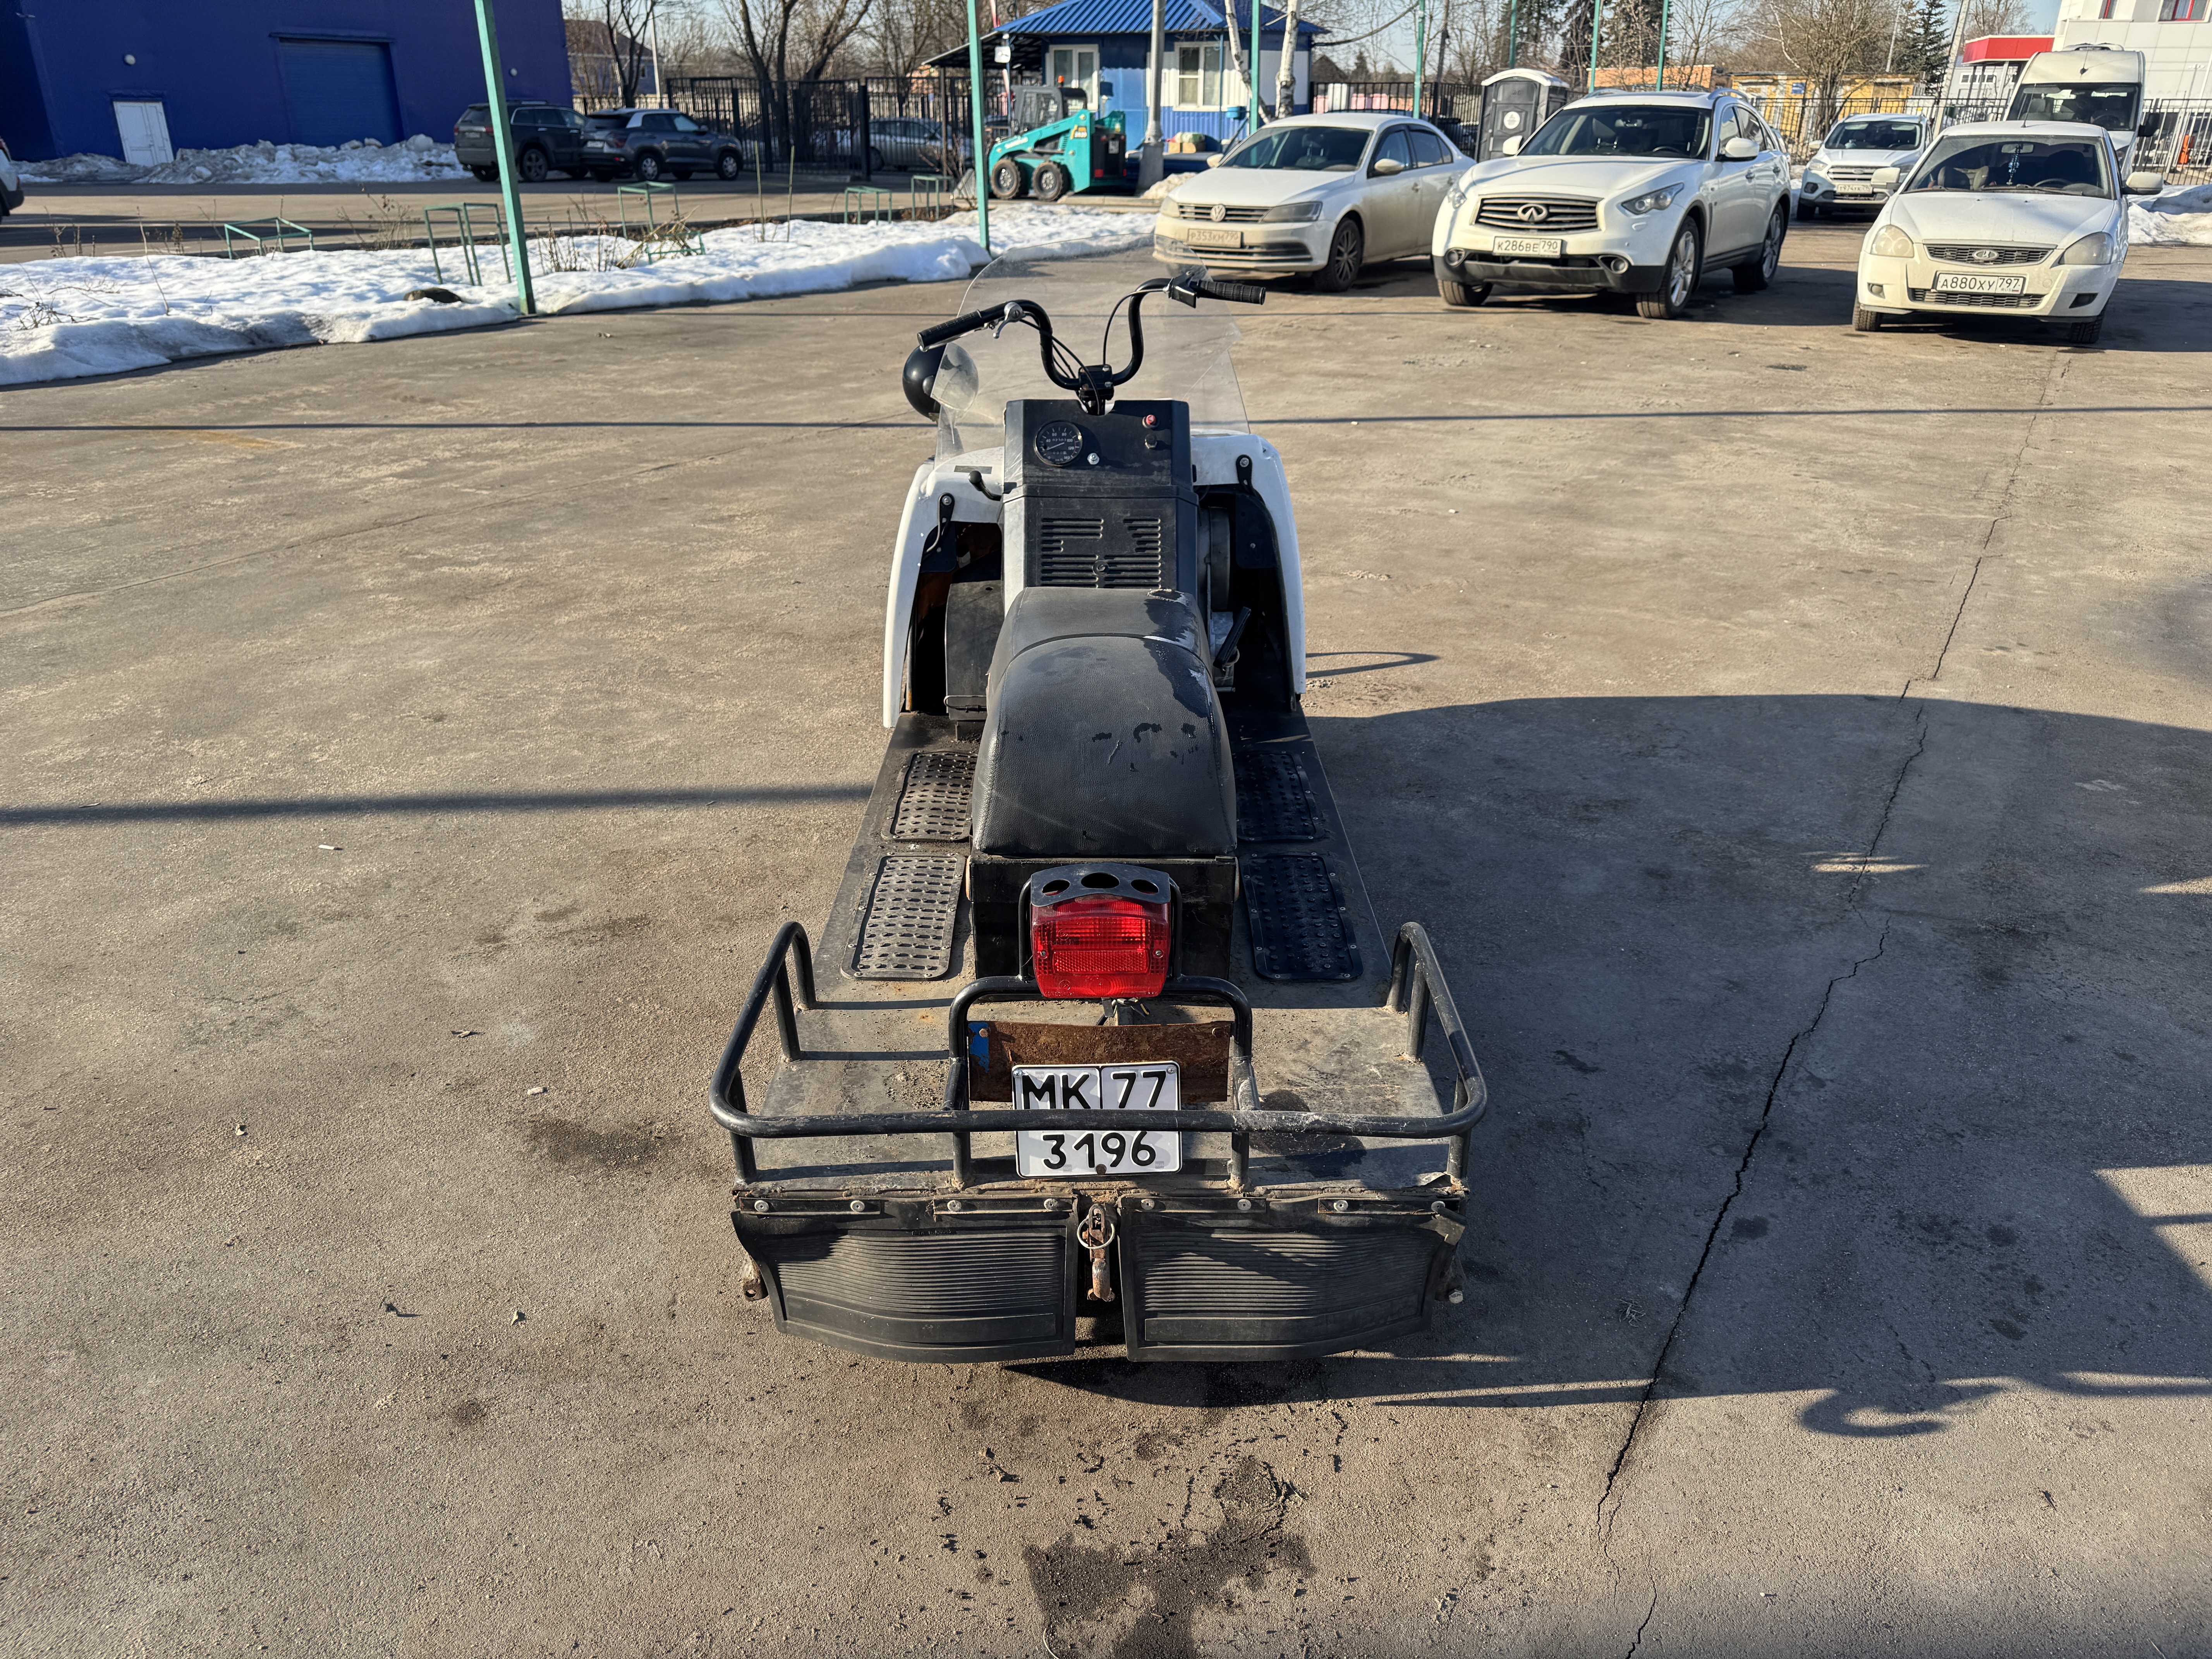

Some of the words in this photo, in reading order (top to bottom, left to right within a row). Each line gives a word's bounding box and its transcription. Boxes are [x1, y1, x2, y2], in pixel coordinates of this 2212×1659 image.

[1497, 240, 1539, 252] К286ВЕ
[1542, 240, 1558, 250] 790
[1941, 276, 1995, 290] А880ХУ
[1999, 278, 2020, 289] 797
[1022, 1074, 1091, 1109] МК
[1112, 1070, 1166, 1108] 77
[1043, 1131, 1156, 1170] 3196
